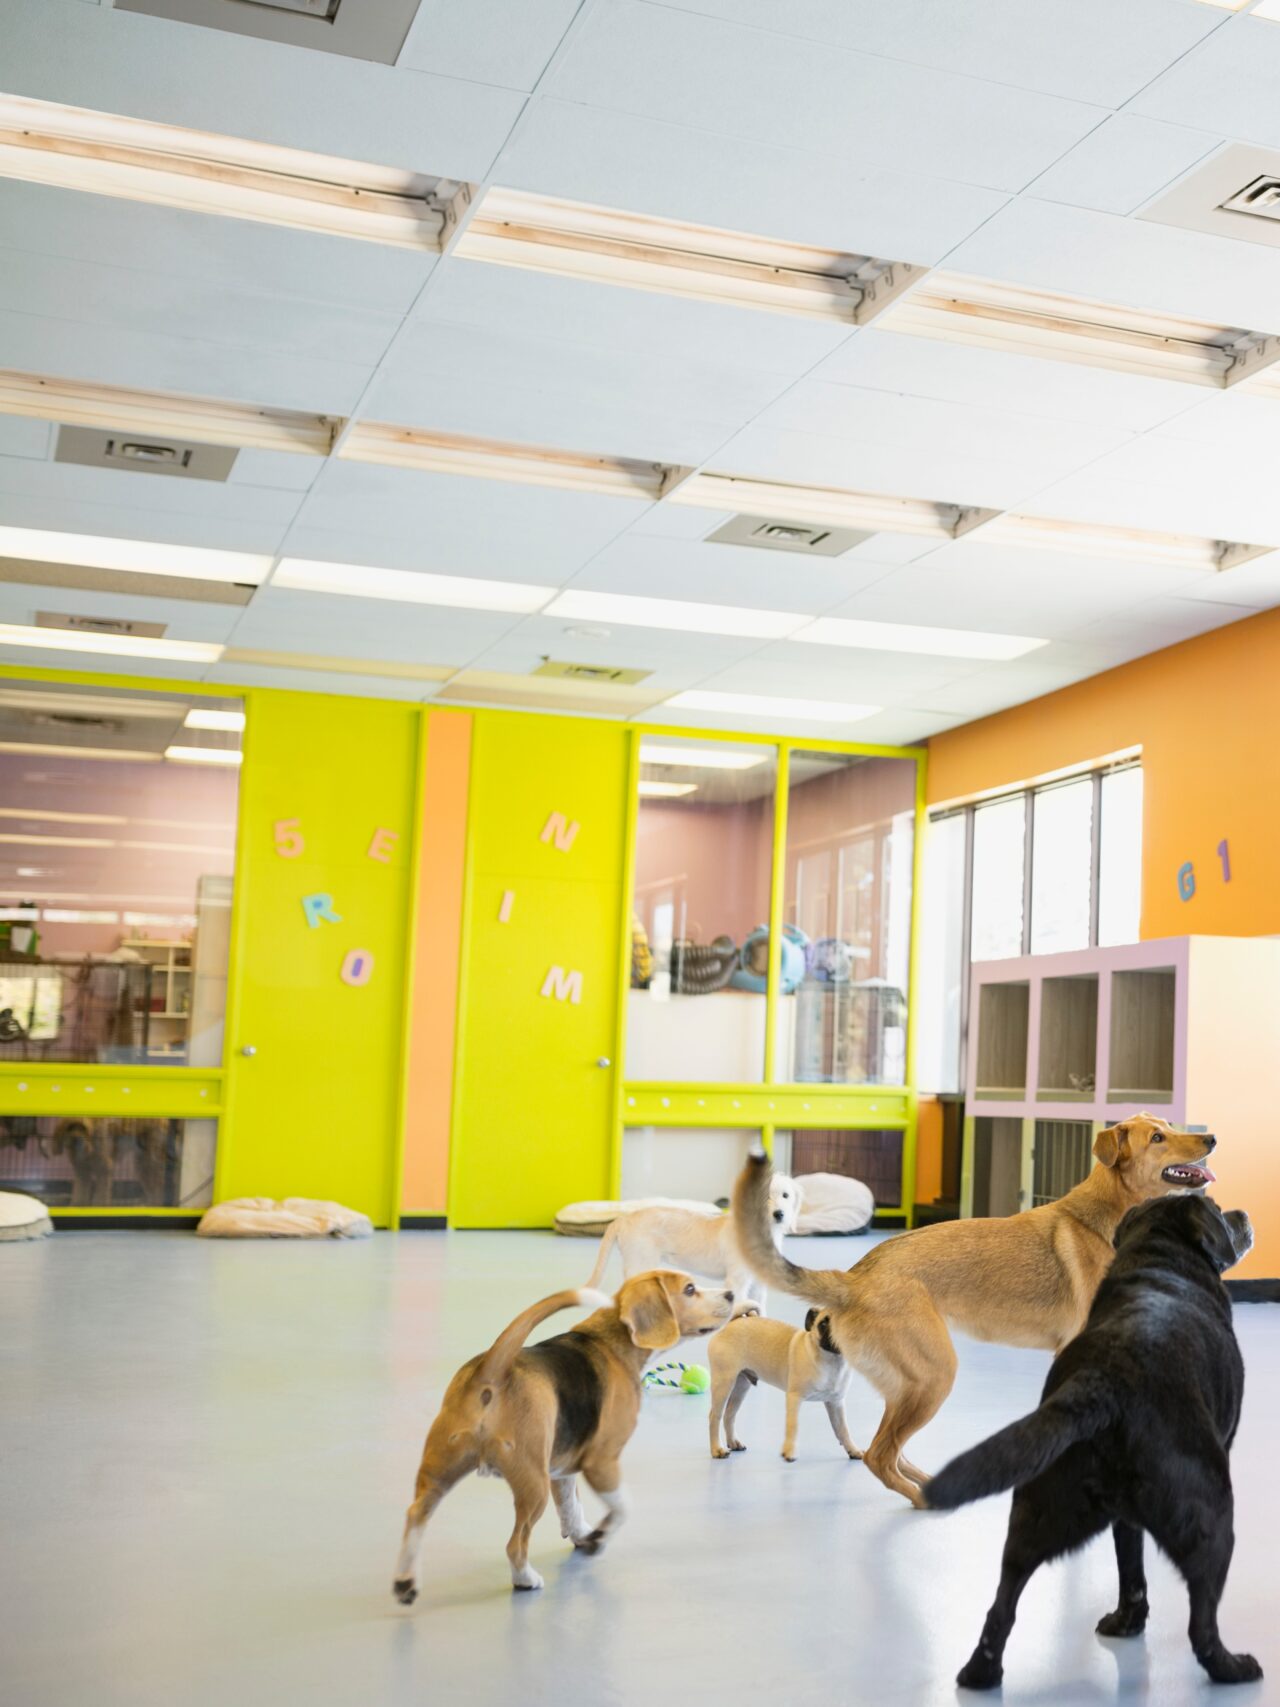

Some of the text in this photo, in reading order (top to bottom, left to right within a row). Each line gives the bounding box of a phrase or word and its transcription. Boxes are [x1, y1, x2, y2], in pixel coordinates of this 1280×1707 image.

[274, 818, 304, 858] 5
[368, 827, 398, 863] E
[540, 812, 579, 852] N
[1217, 839, 1231, 883] 1
[303, 893, 342, 928] R
[540, 966, 583, 1004] M
